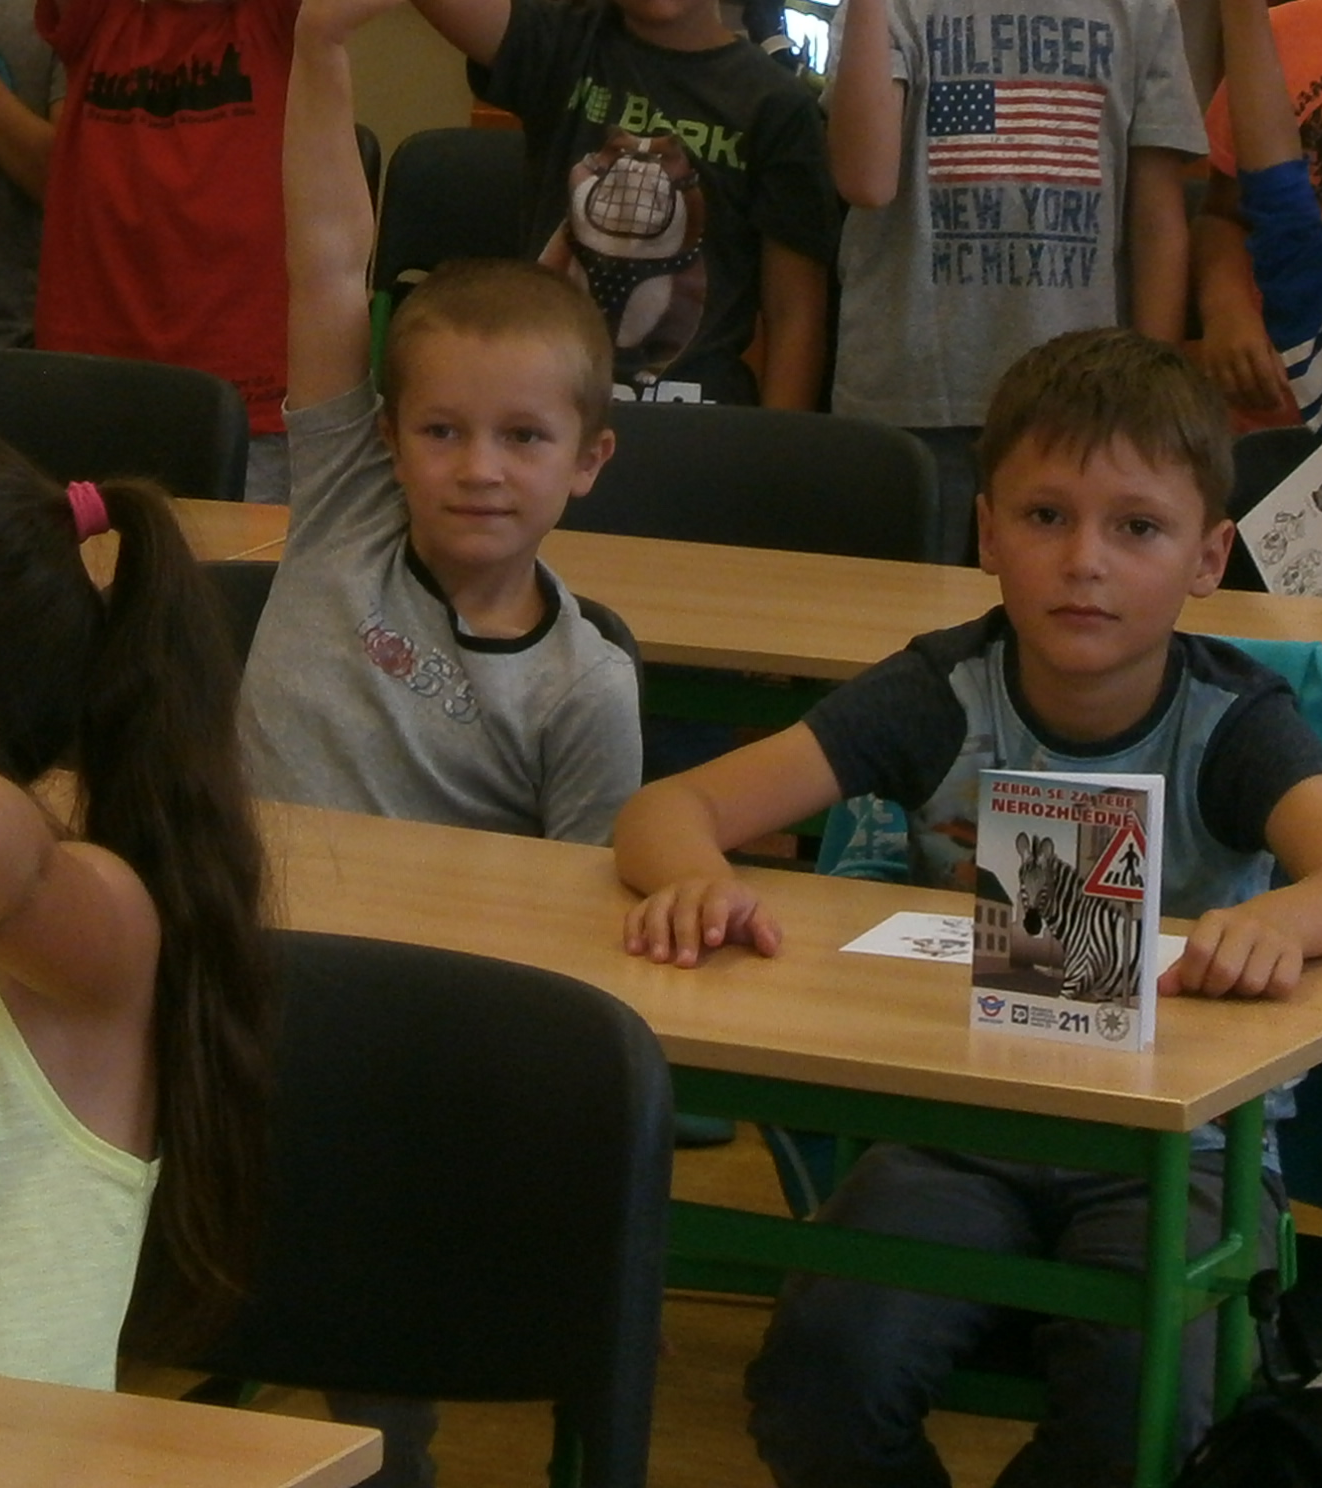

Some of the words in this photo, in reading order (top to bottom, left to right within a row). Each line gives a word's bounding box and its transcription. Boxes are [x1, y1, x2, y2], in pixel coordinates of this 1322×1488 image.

[927, 14, 1114, 79] HILFIGER
[929, 186, 1004, 231] NEW
[1019, 187, 1103, 235] YORK
[992, 781, 1041, 798] ZEBRA
[1047, 787, 1064, 800] SE
[1097, 793, 1135, 809] TEBE
[1058, 1011, 1090, 1035] 211
